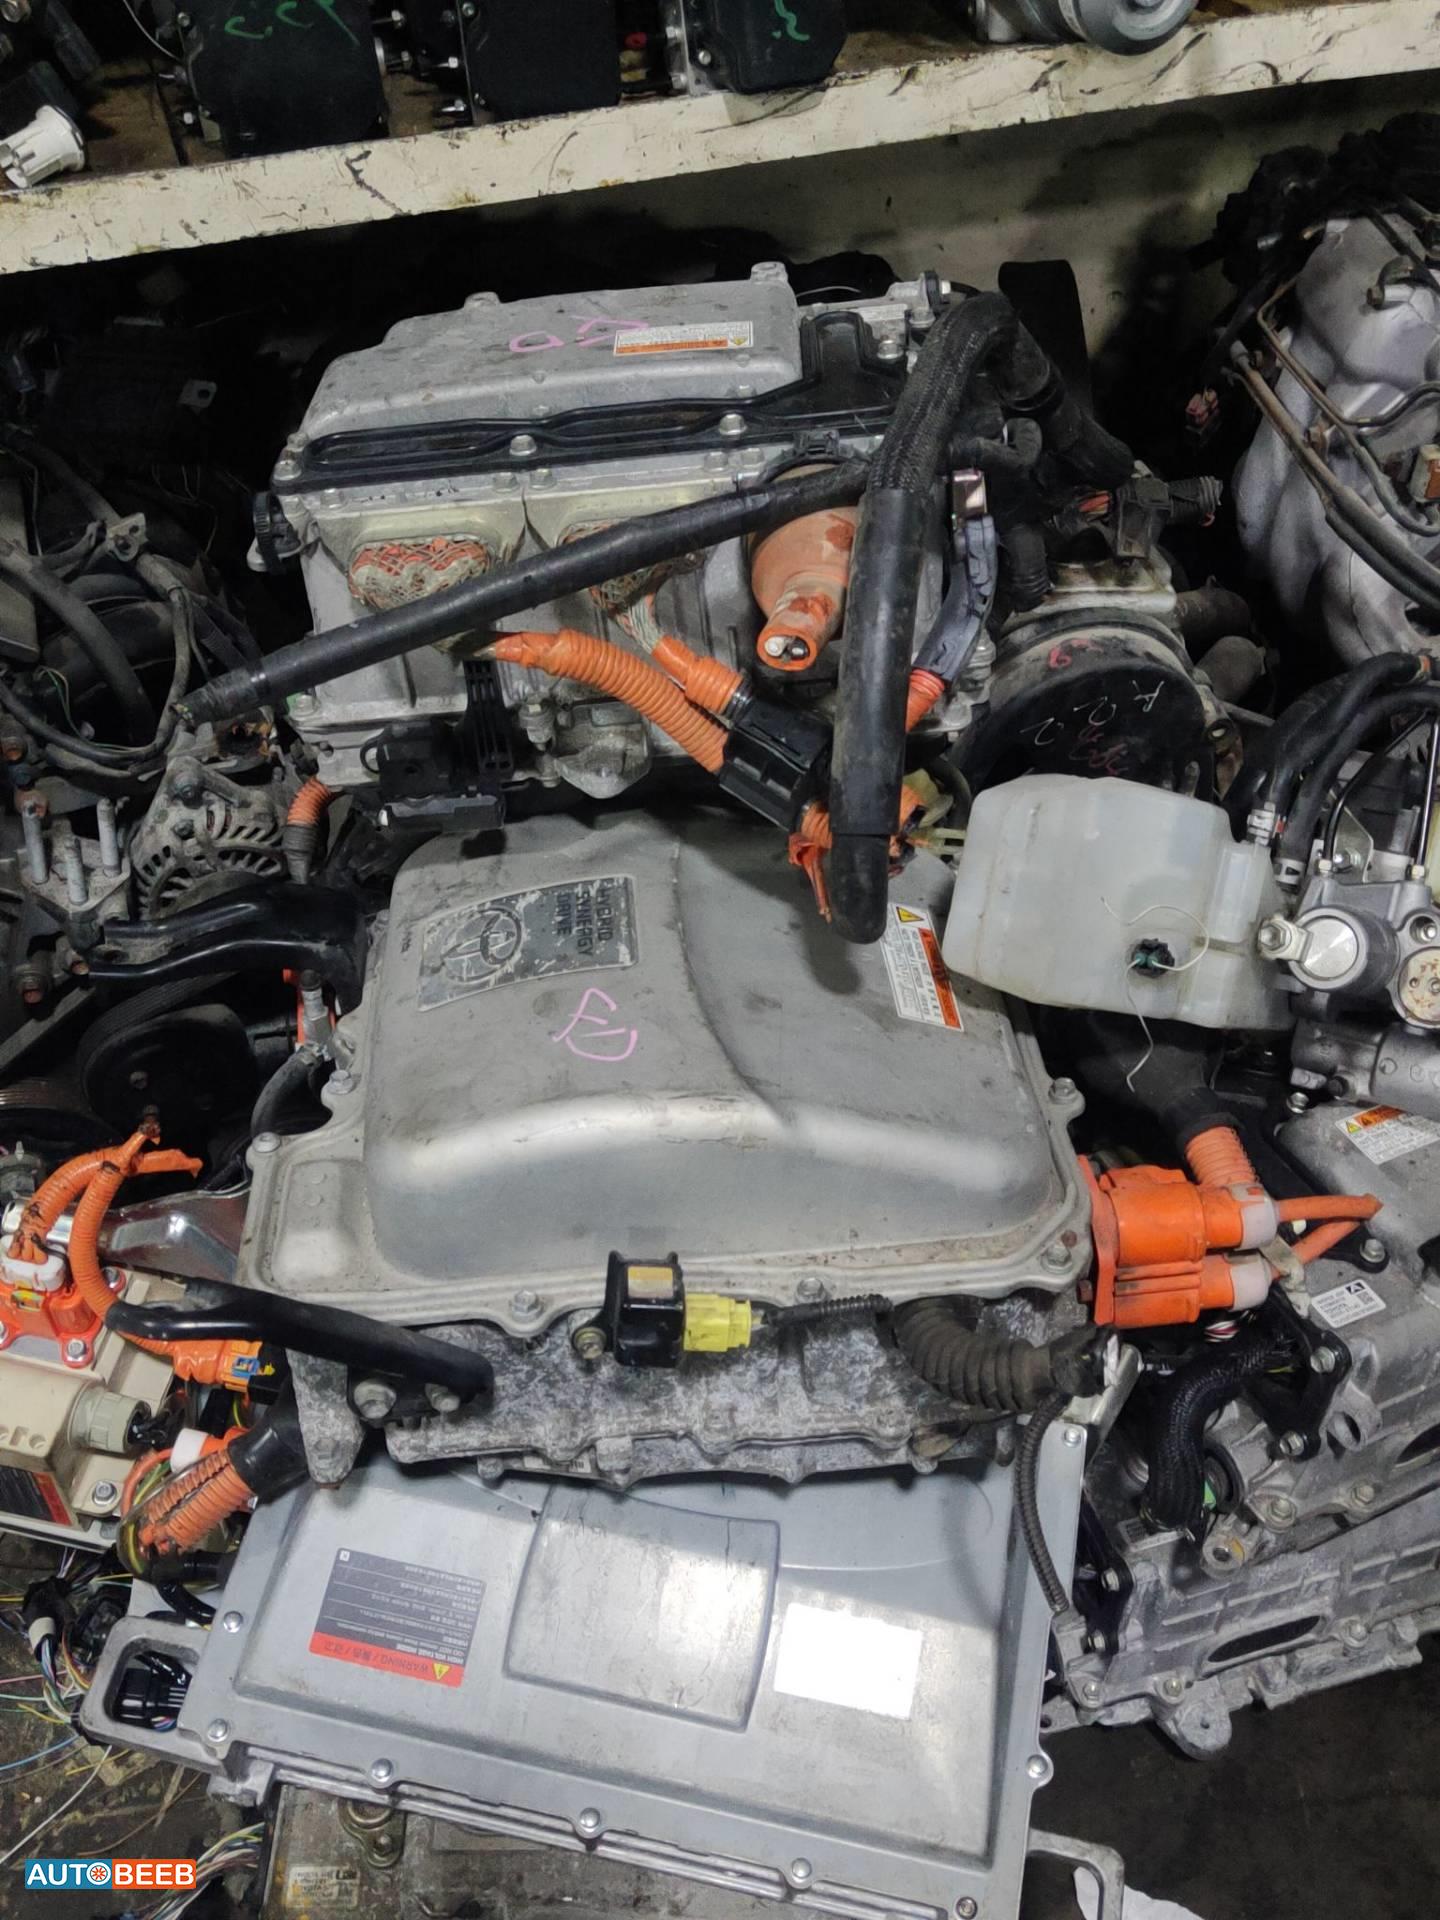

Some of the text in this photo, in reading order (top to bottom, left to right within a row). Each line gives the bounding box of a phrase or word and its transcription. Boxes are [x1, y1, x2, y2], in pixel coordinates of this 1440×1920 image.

[556, 893, 571, 935] DRIVE
[576, 891, 593, 957] SYNERGY
[596, 888, 613, 941] HYBRID
[380, 1654, 429, 1673] WARNING
